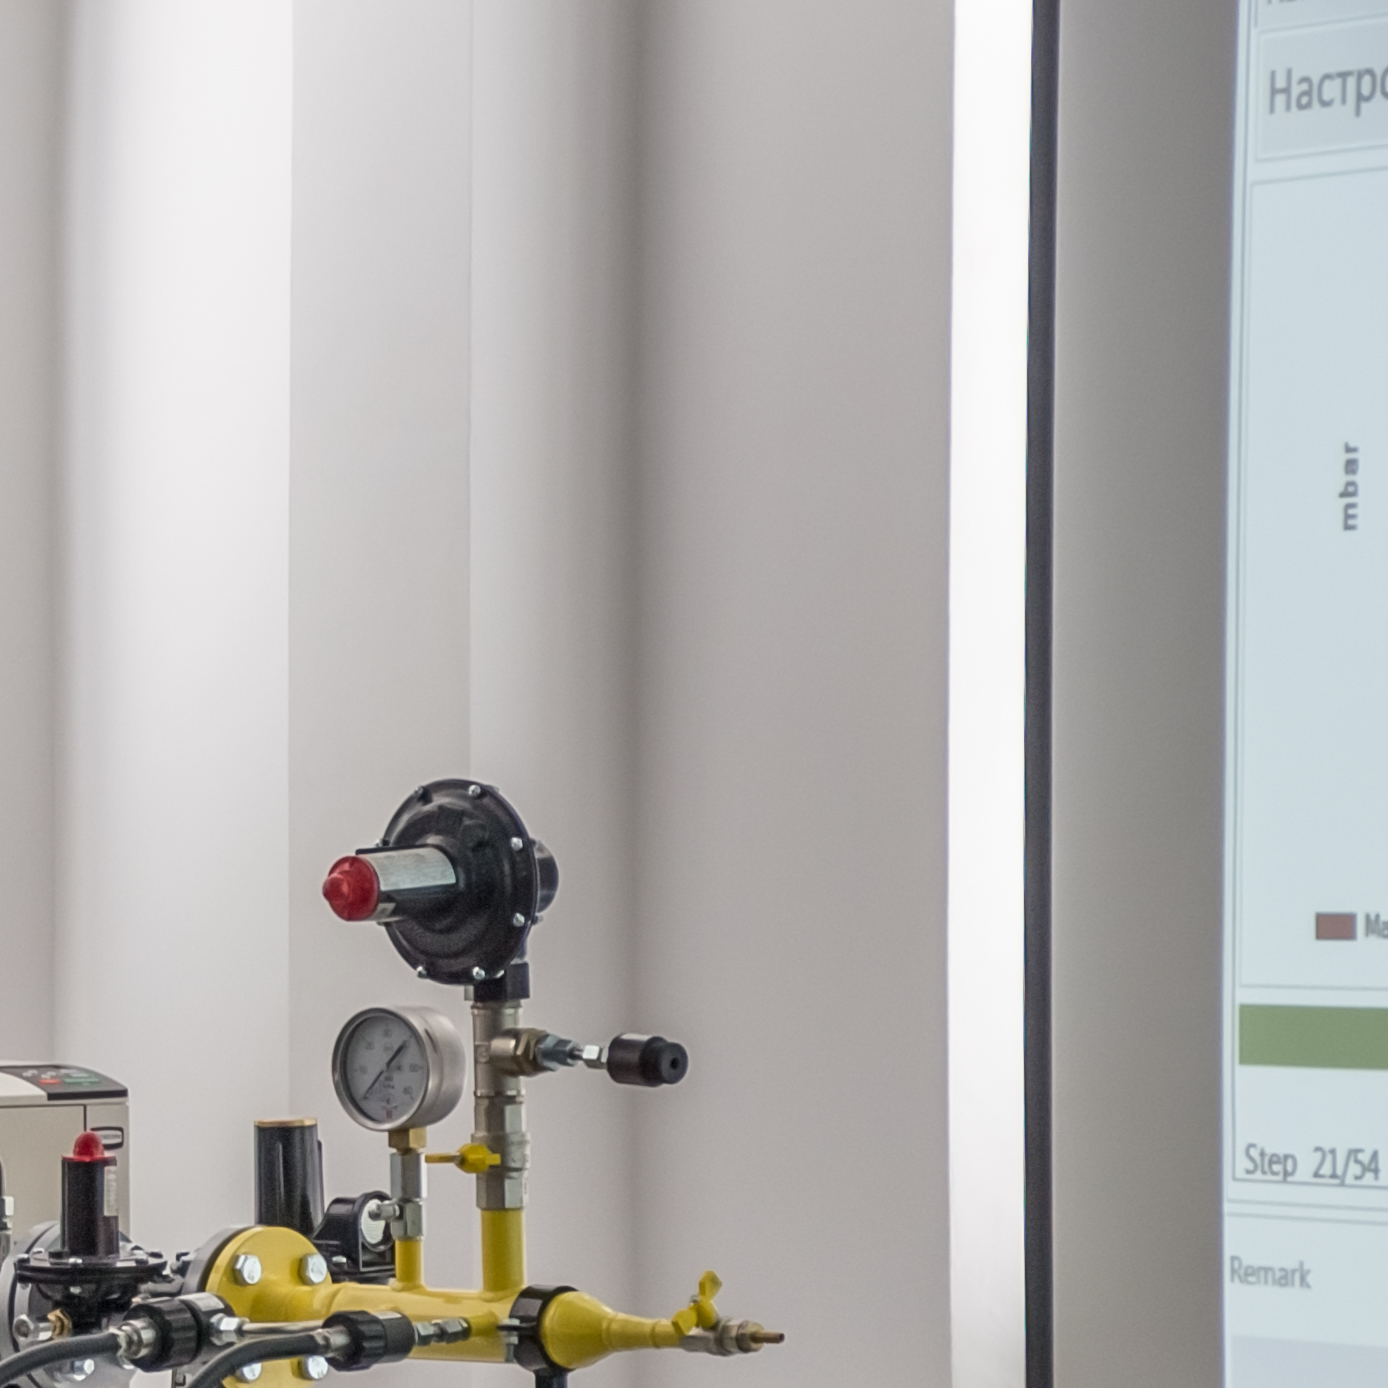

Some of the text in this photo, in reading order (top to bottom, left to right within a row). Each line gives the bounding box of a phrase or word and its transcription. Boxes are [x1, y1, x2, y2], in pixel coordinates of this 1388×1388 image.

[1338, 441, 1360, 531] mbar
[1244, 1143, 1381, 1186] Step 21/54
[1229, 1255, 1313, 1290] Remark
